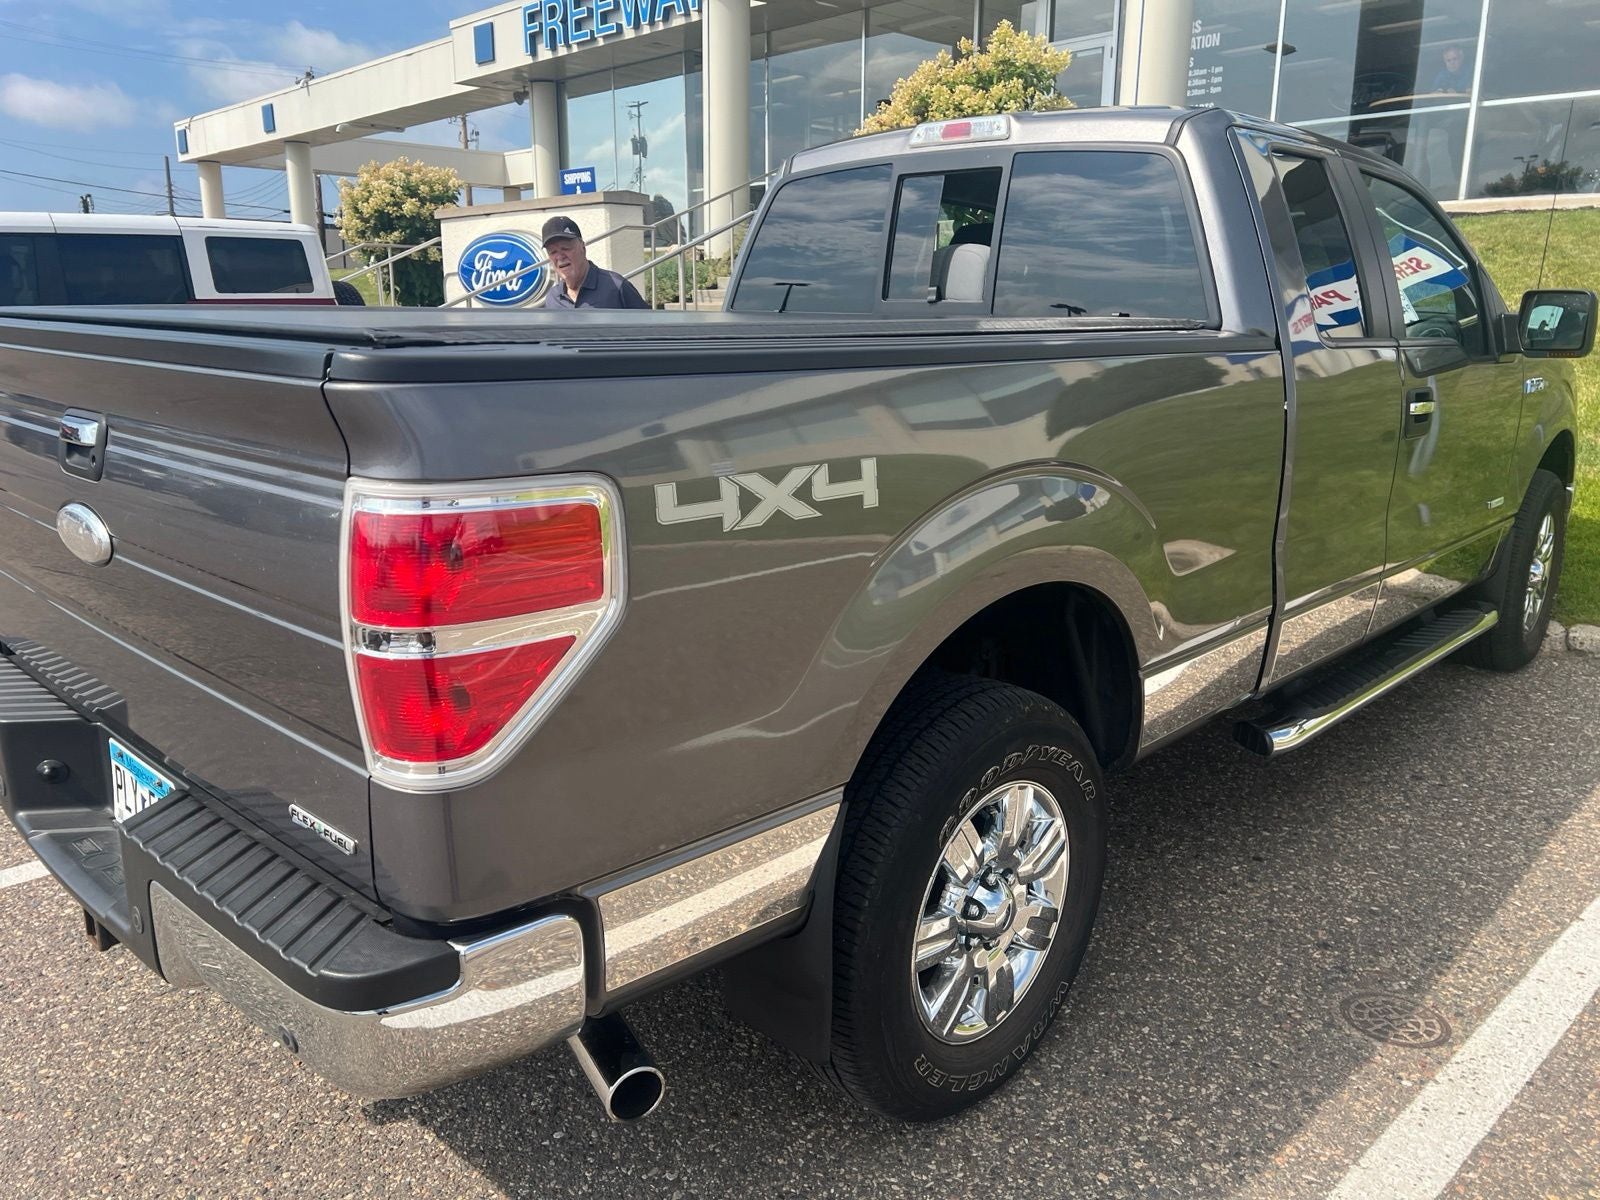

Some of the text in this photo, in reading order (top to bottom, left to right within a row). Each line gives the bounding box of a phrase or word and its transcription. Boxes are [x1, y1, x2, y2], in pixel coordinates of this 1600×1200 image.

[522, 0, 699, 55] FREEW
[471, 249, 523, 292] Ford
[290, 808, 352, 852] FLEX FUEL
